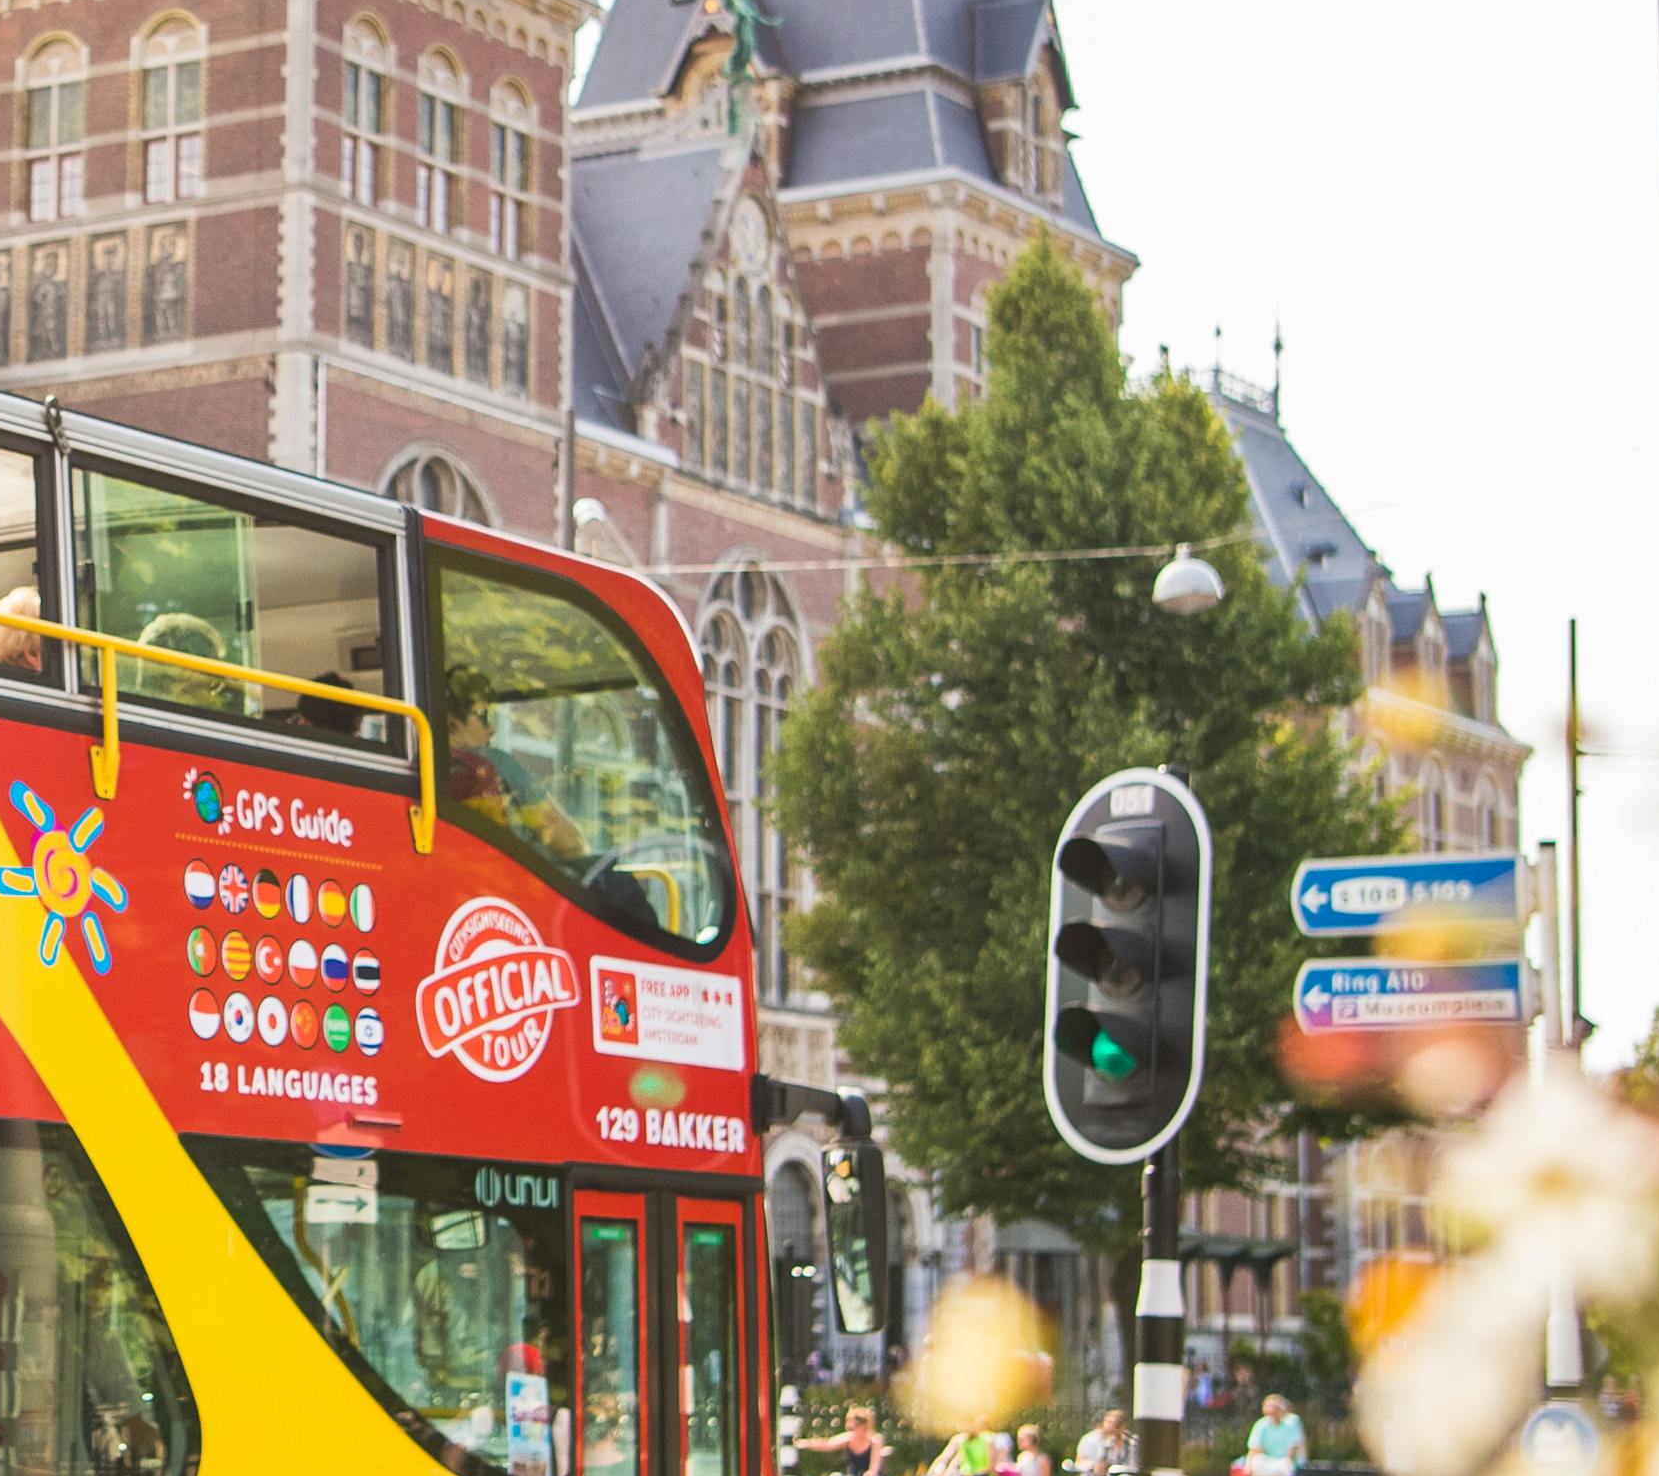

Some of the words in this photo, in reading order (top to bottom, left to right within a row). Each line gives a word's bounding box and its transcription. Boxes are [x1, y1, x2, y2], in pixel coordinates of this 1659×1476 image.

[236, 789, 284, 836] GPS
[290, 798, 354, 848] Guide
[434, 958, 572, 1038] OFFICIAL
[640, 978, 665, 998] FREE
[669, 982, 690, 998] APP
[1332, 972, 1379, 994] Ring
[1386, 971, 1424, 992] A10
[481, 1017, 544, 1068] TOUR
[199, 1060, 229, 1093] 18
[237, 1064, 378, 1106] LANGUAGES
[596, 1105, 640, 1143] 129
[645, 1108, 746, 1154] BAKKER
